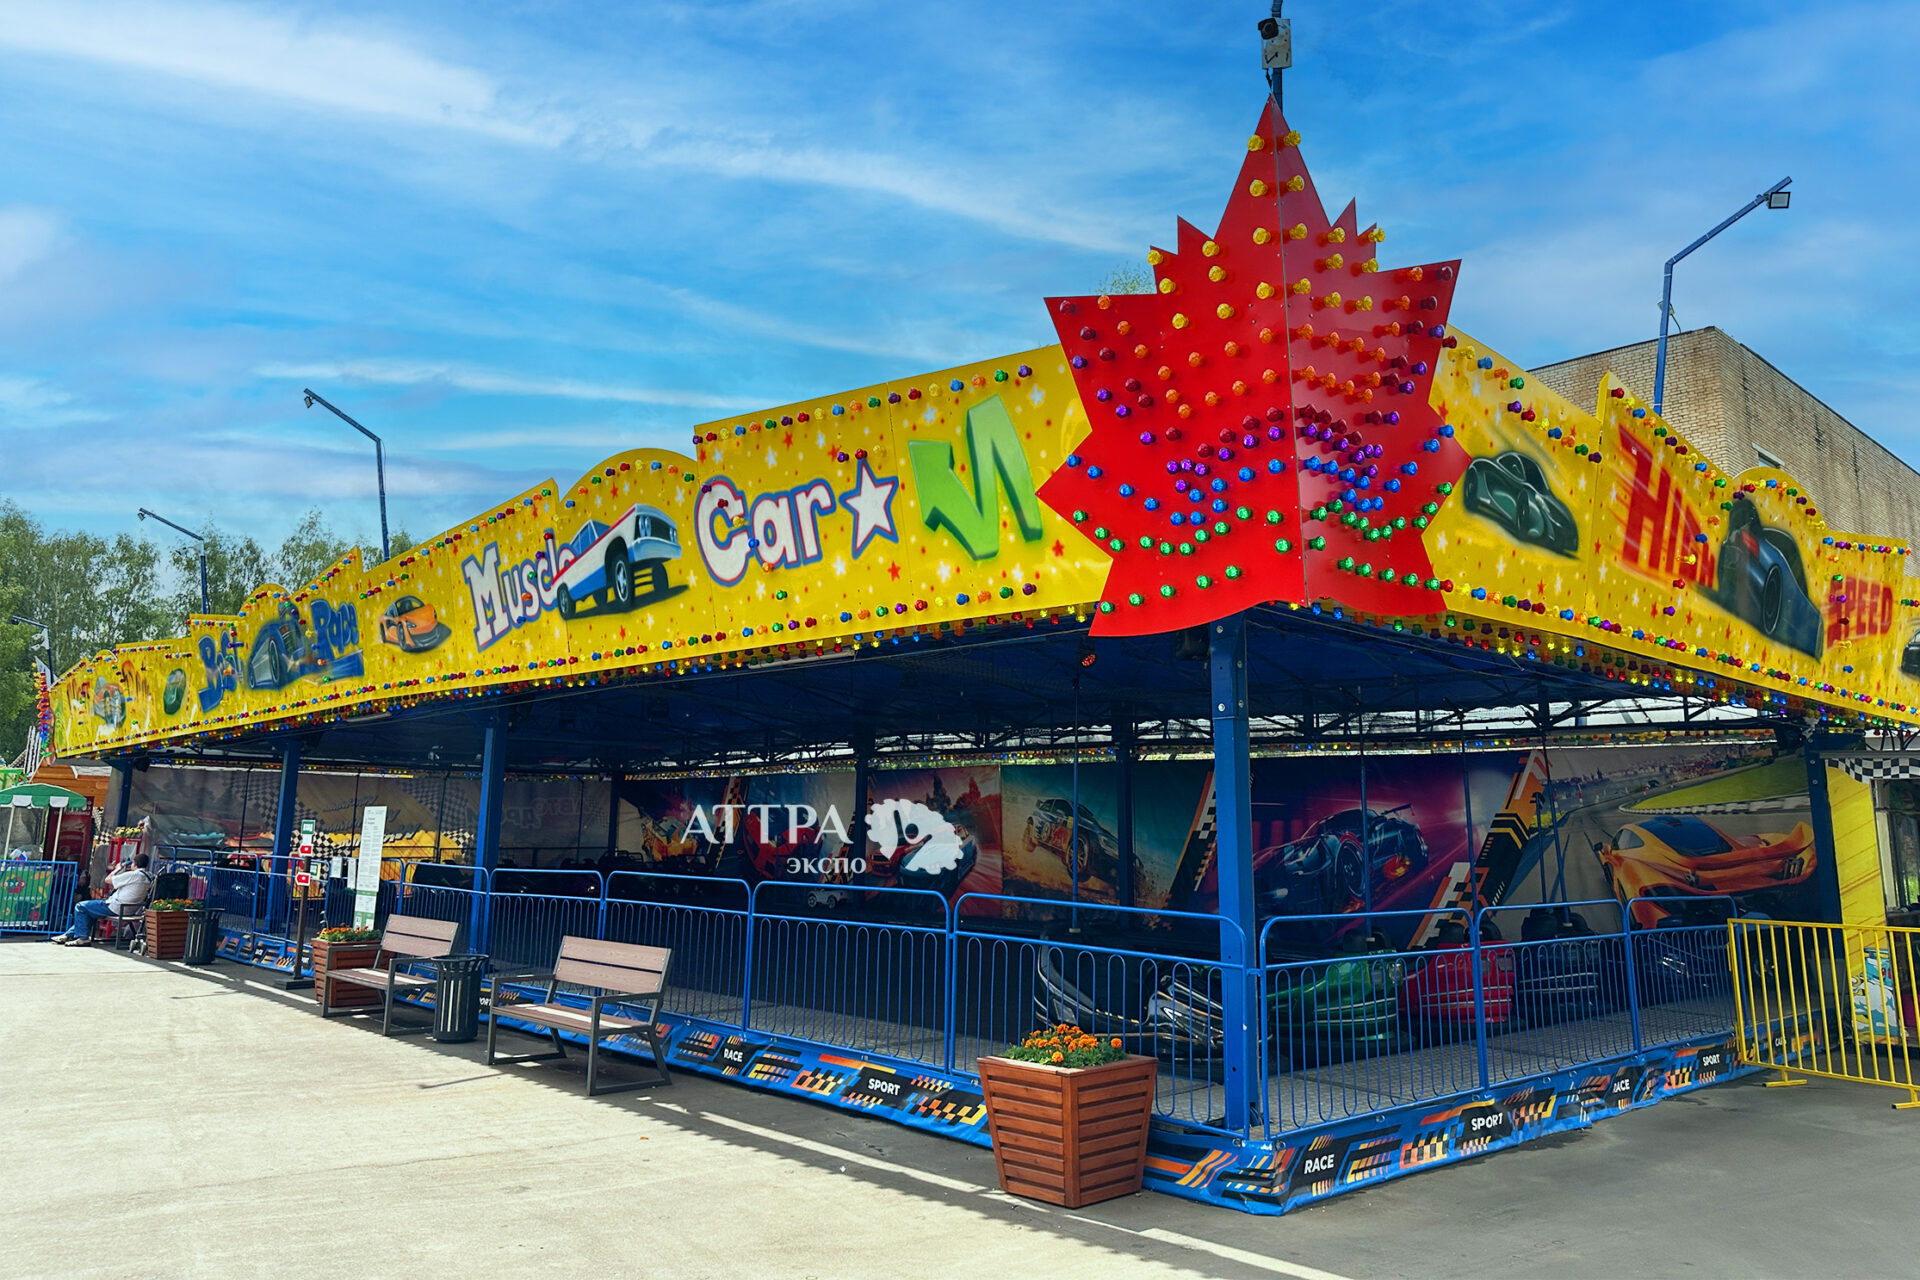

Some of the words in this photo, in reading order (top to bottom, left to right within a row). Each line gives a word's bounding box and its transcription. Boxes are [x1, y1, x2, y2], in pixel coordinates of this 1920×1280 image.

[694, 474, 836, 588] Car
[1618, 423, 1717, 591] HIGH
[1827, 575, 1893, 649] SPEED
[306, 598, 364, 668] Race
[723, 1048, 743, 1062] RACE
[1703, 1053, 1720, 1067] SPORT
[868, 1078, 901, 1096] SPORT
[1471, 1112, 1503, 1131] SPORT
[1303, 1153, 1335, 1175] RACE
